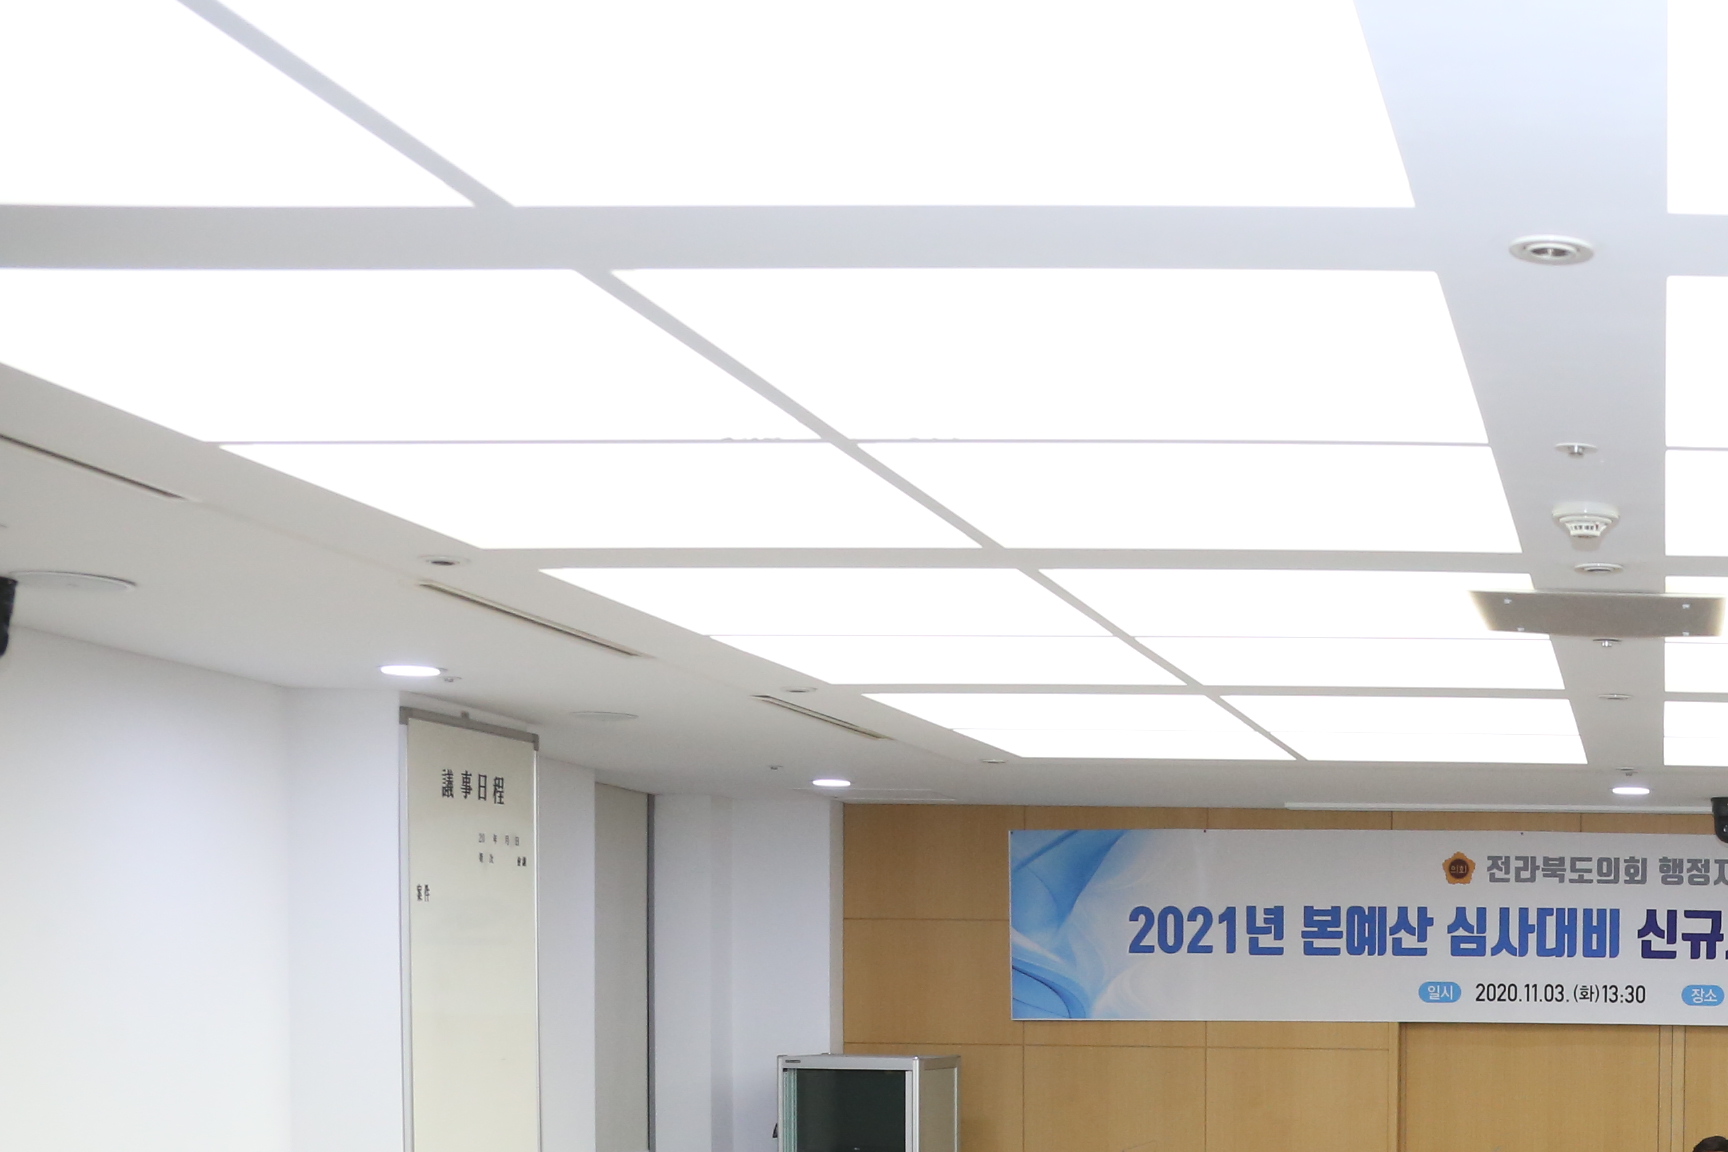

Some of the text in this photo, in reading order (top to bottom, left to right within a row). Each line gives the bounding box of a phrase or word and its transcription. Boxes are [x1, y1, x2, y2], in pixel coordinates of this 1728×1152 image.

[1486, 855, 1648, 885] 전라북도의회
[1128, 905, 1285, 956] 2021년
[1300, 905, 1435, 958] 본예산
[1446, 906, 1621, 959] 심사대비
[1427, 985, 1454, 1001] 일시
[1691, 987, 1719, 1003] 장소
